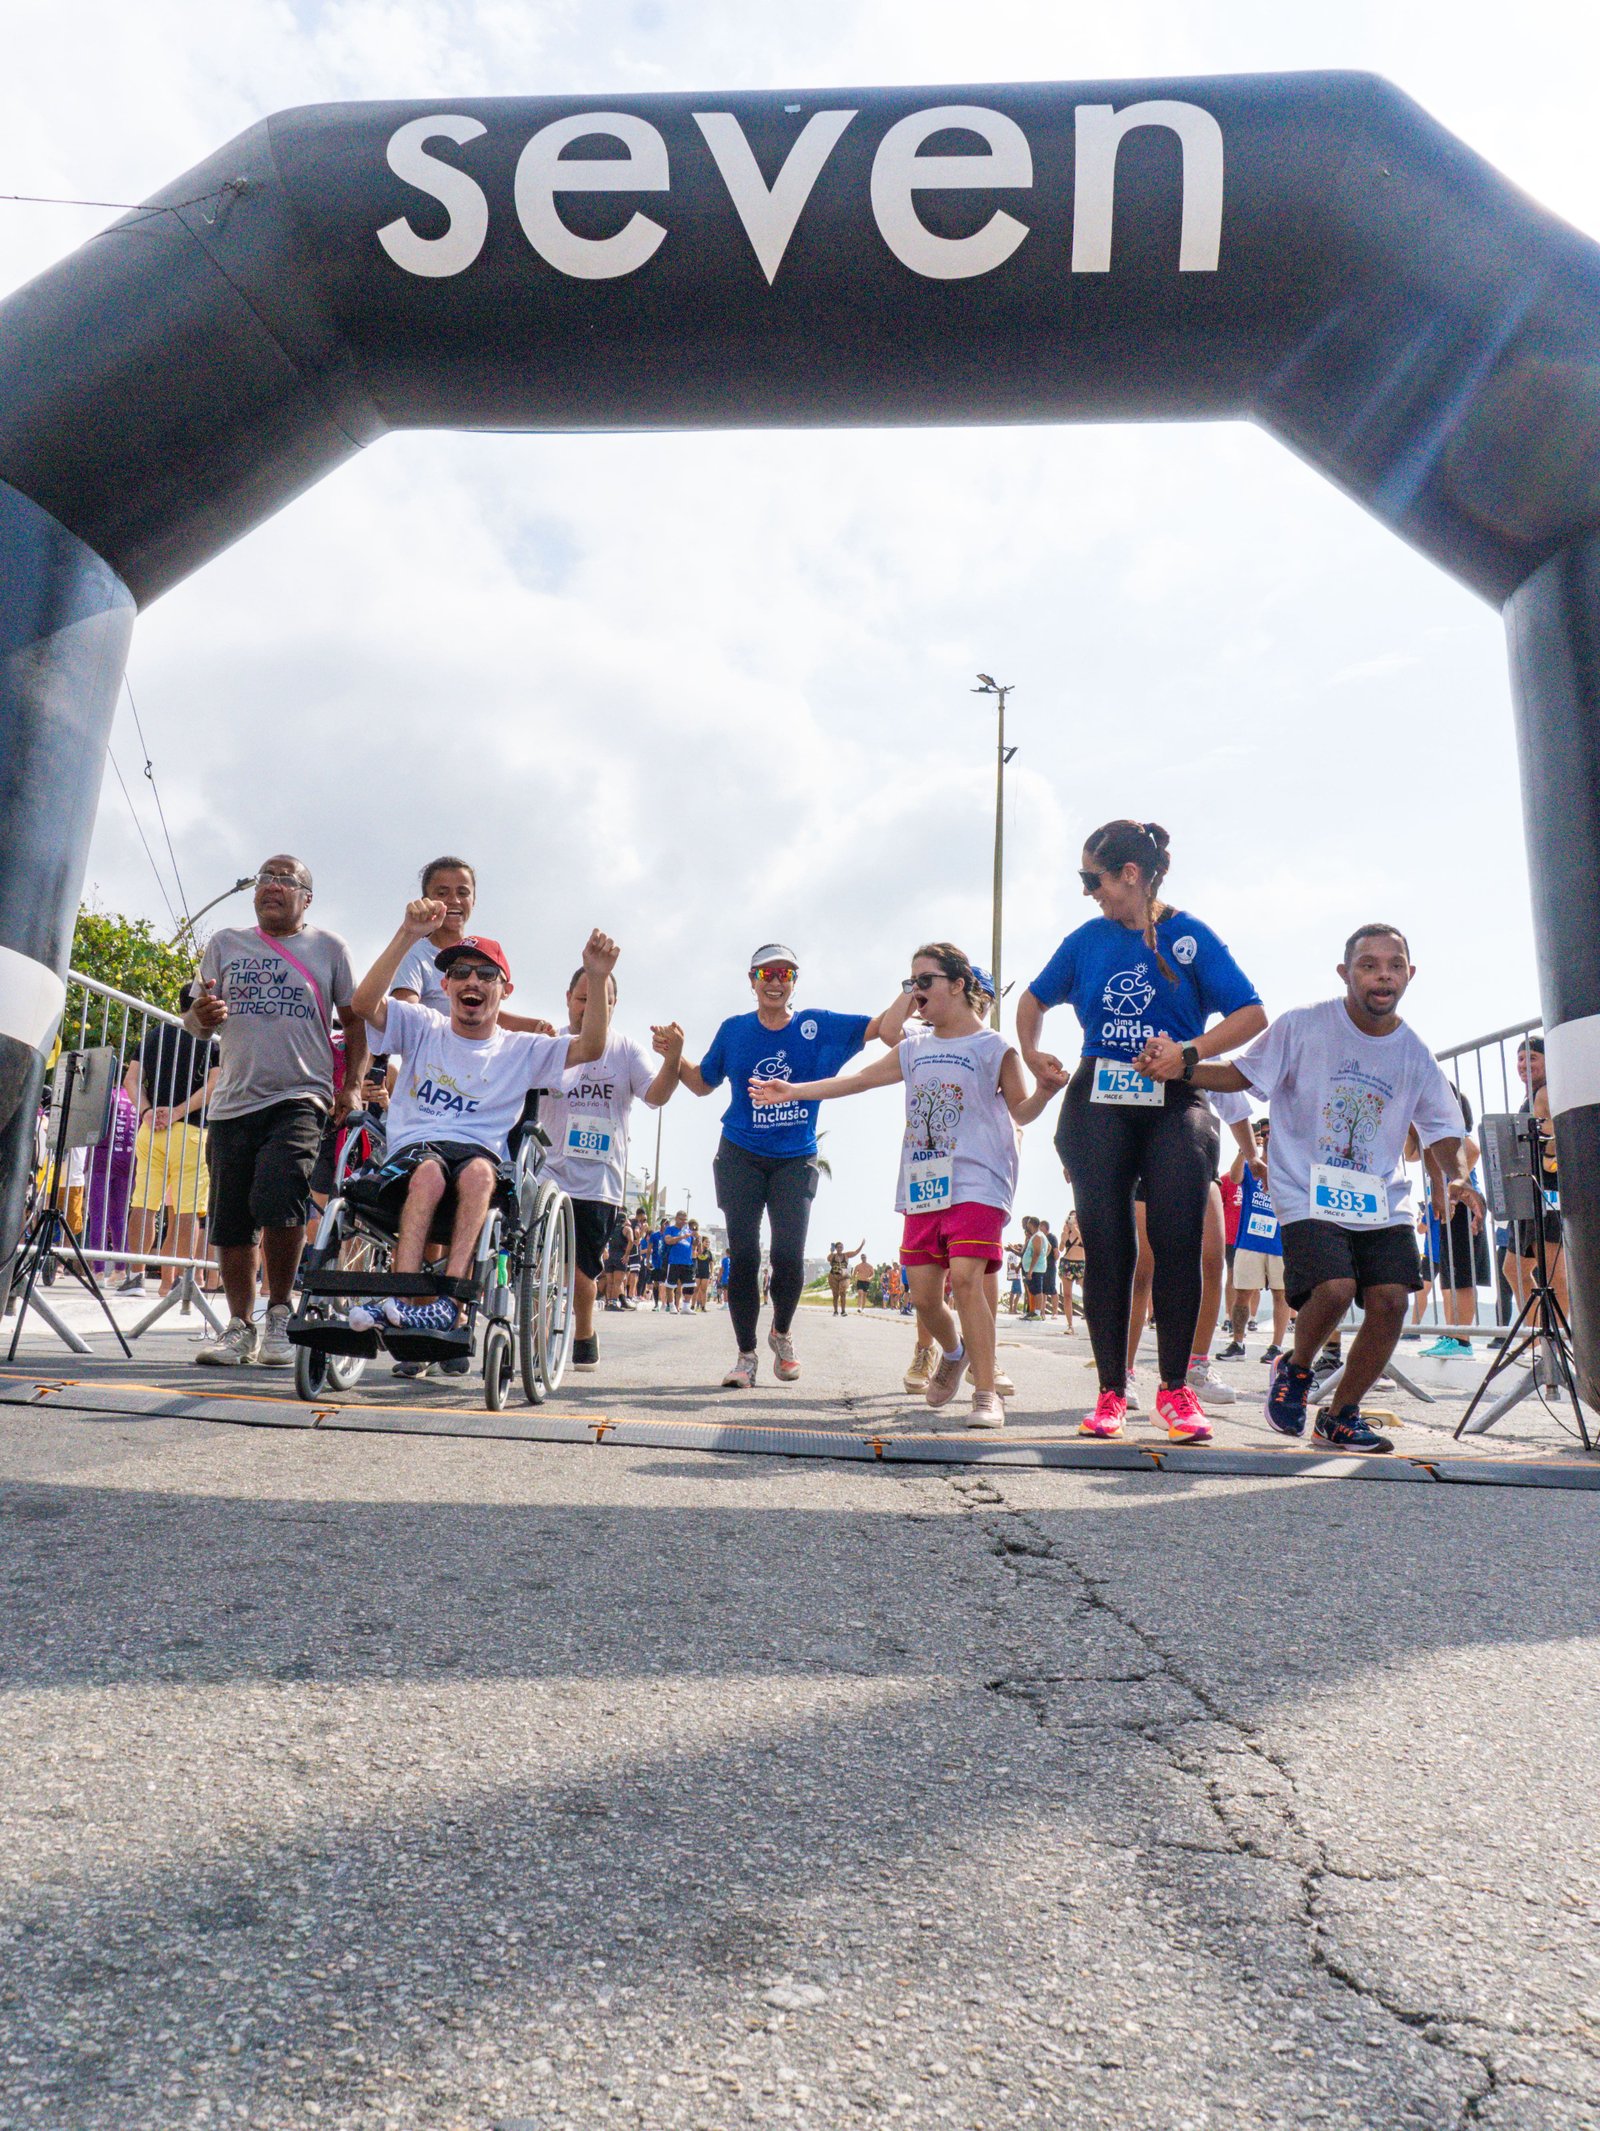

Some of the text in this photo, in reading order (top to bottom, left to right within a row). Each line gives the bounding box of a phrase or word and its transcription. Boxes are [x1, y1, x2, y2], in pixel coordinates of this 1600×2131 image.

[376, 99, 1224, 287] seven
[231, 959, 282, 970] START
[230, 971, 288, 984] THROW
[229, 986, 304, 1001] EXPLODE
[1101, 1020, 1155, 1039] Onda
[1113, 1018, 1133, 1026] Uma
[1107, 1071, 1144, 1092] 754
[567, 1083, 615, 1099] APAE
[752, 1106, 809, 1123] Inclusão
[578, 1132, 603, 1149] 881
[917, 1178, 944, 1201] 394
[1327, 1187, 1366, 1211] 393
[1323, 1209, 1340, 1217] PACE
